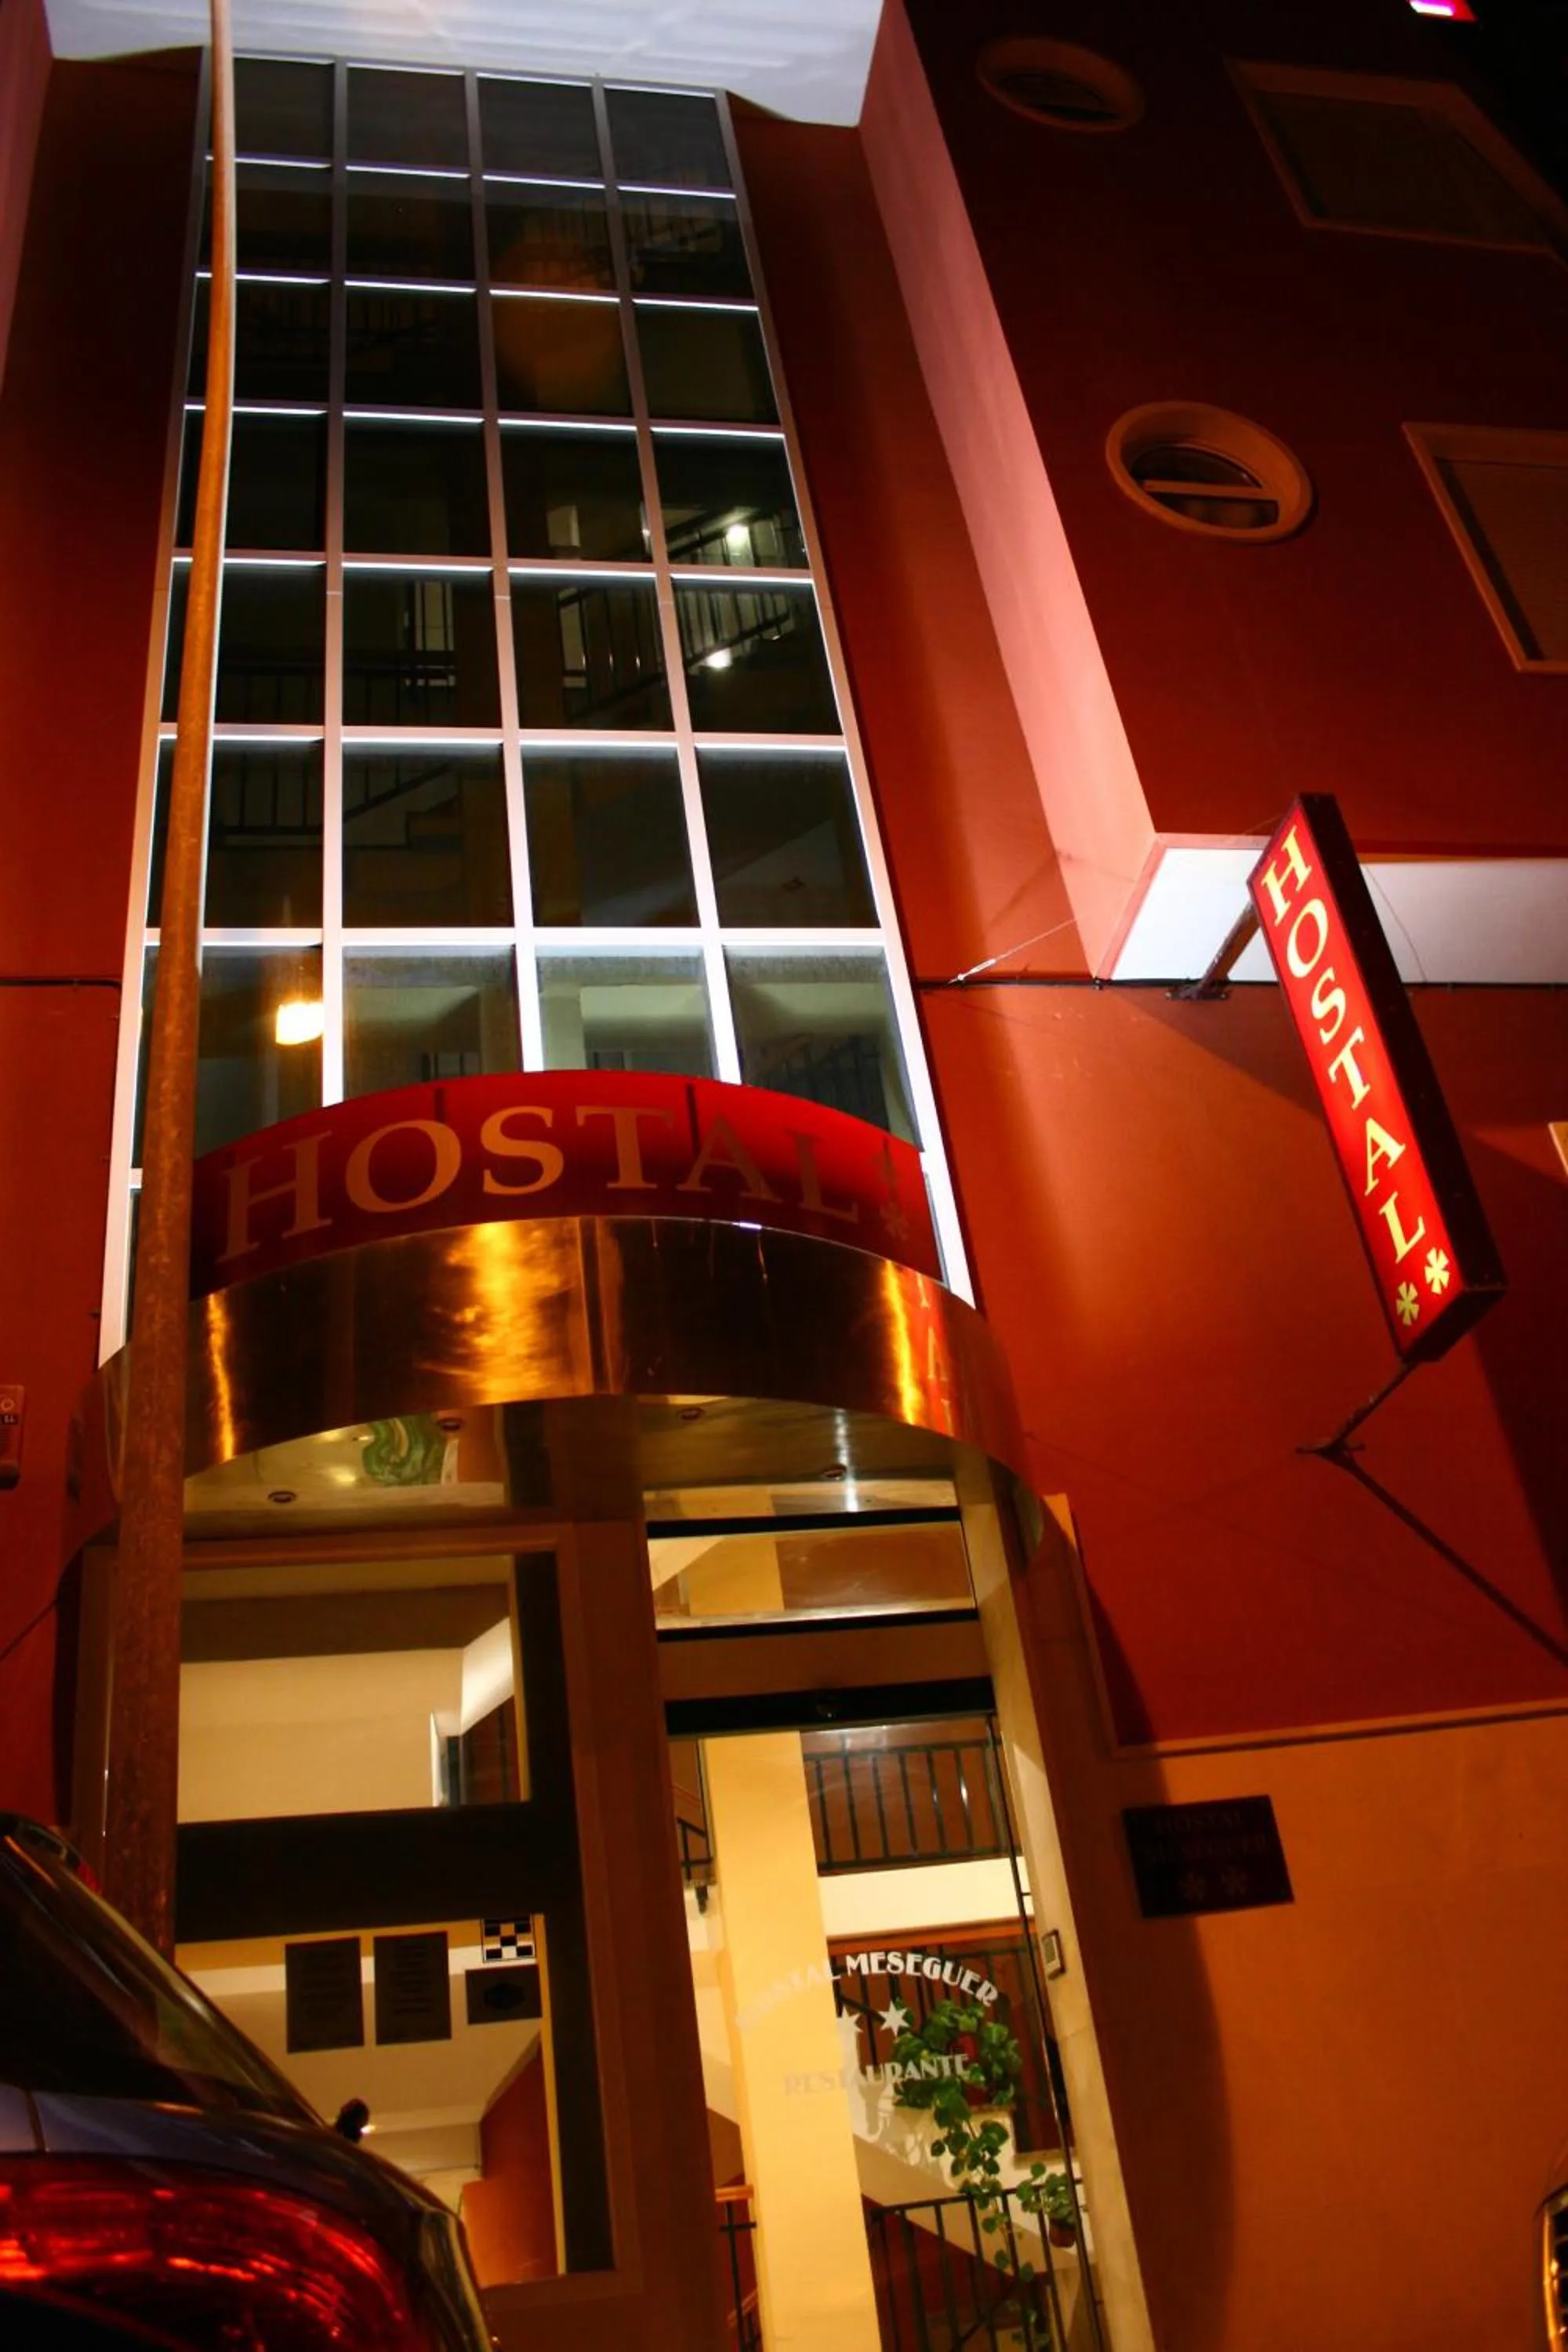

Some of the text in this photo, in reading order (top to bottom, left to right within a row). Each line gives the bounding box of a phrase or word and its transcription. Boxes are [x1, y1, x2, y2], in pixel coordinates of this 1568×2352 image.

[1260, 825, 1426, 1265] HOSTAL
[223, 1106, 858, 1260] HOSTAL
[846, 1951, 999, 2008] MESEGUER
